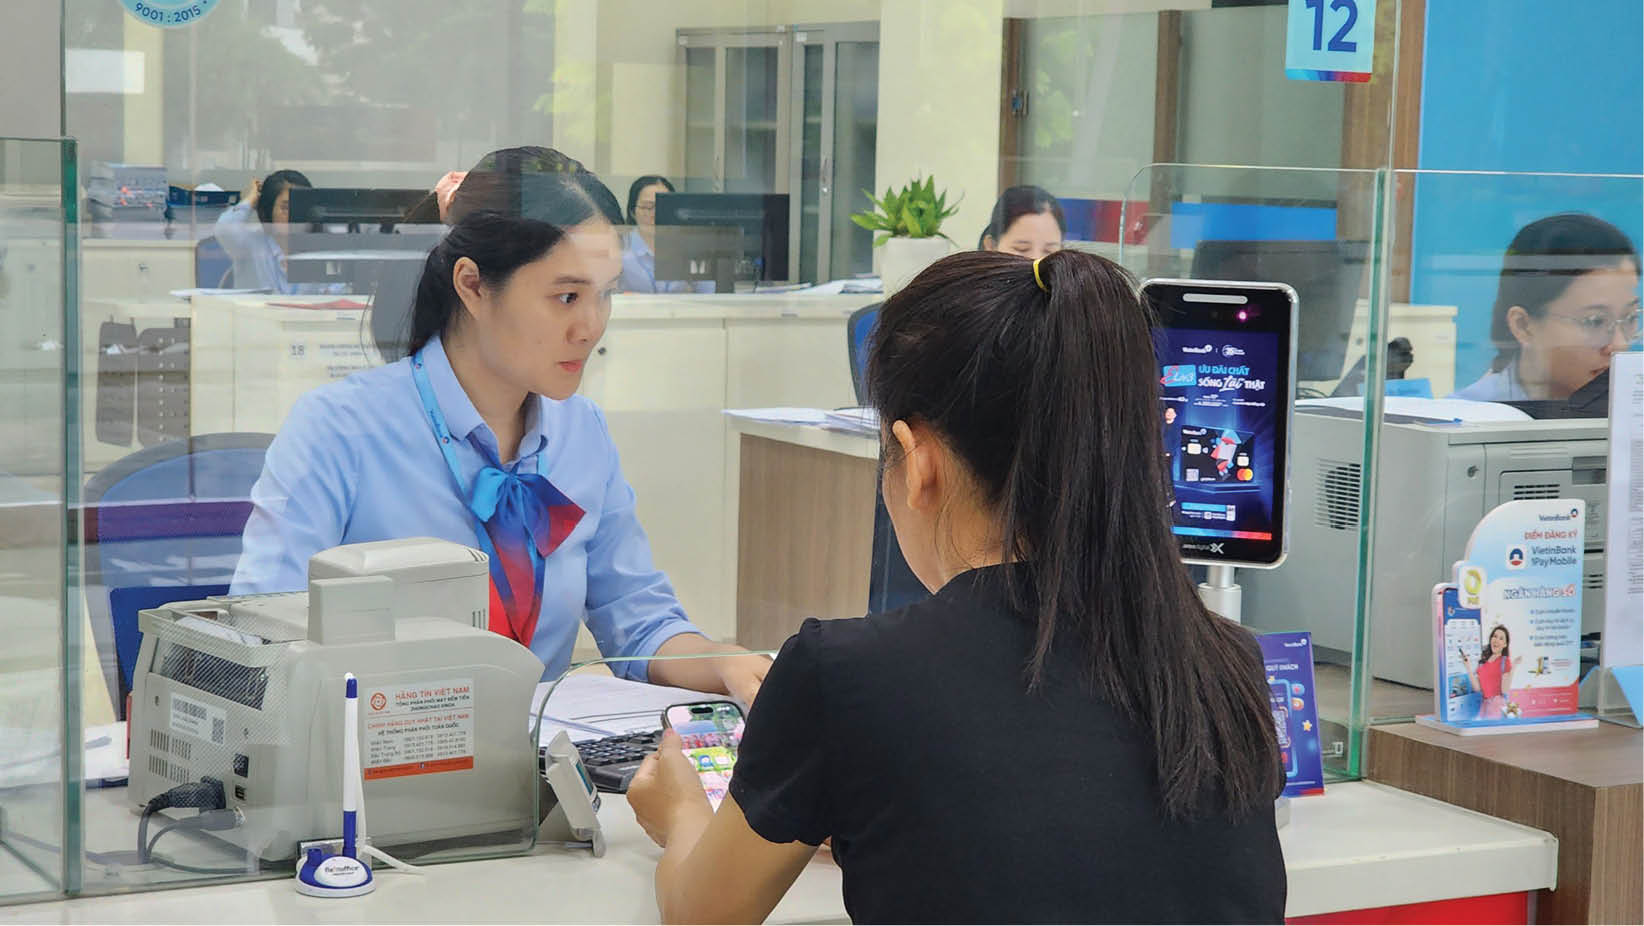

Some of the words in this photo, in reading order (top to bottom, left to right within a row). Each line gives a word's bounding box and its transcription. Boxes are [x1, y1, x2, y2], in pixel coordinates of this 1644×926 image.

[135, 2, 163, 21] 9001
[174, 4, 201, 22] 2015
[1305, 0, 1358, 52] 12
[1228, 365, 1250, 376] CHẤT
[1197, 376, 1223, 388] SỐNG
[1531, 545, 1577, 555] VietinBank
[454, 685, 470, 695] NAM
